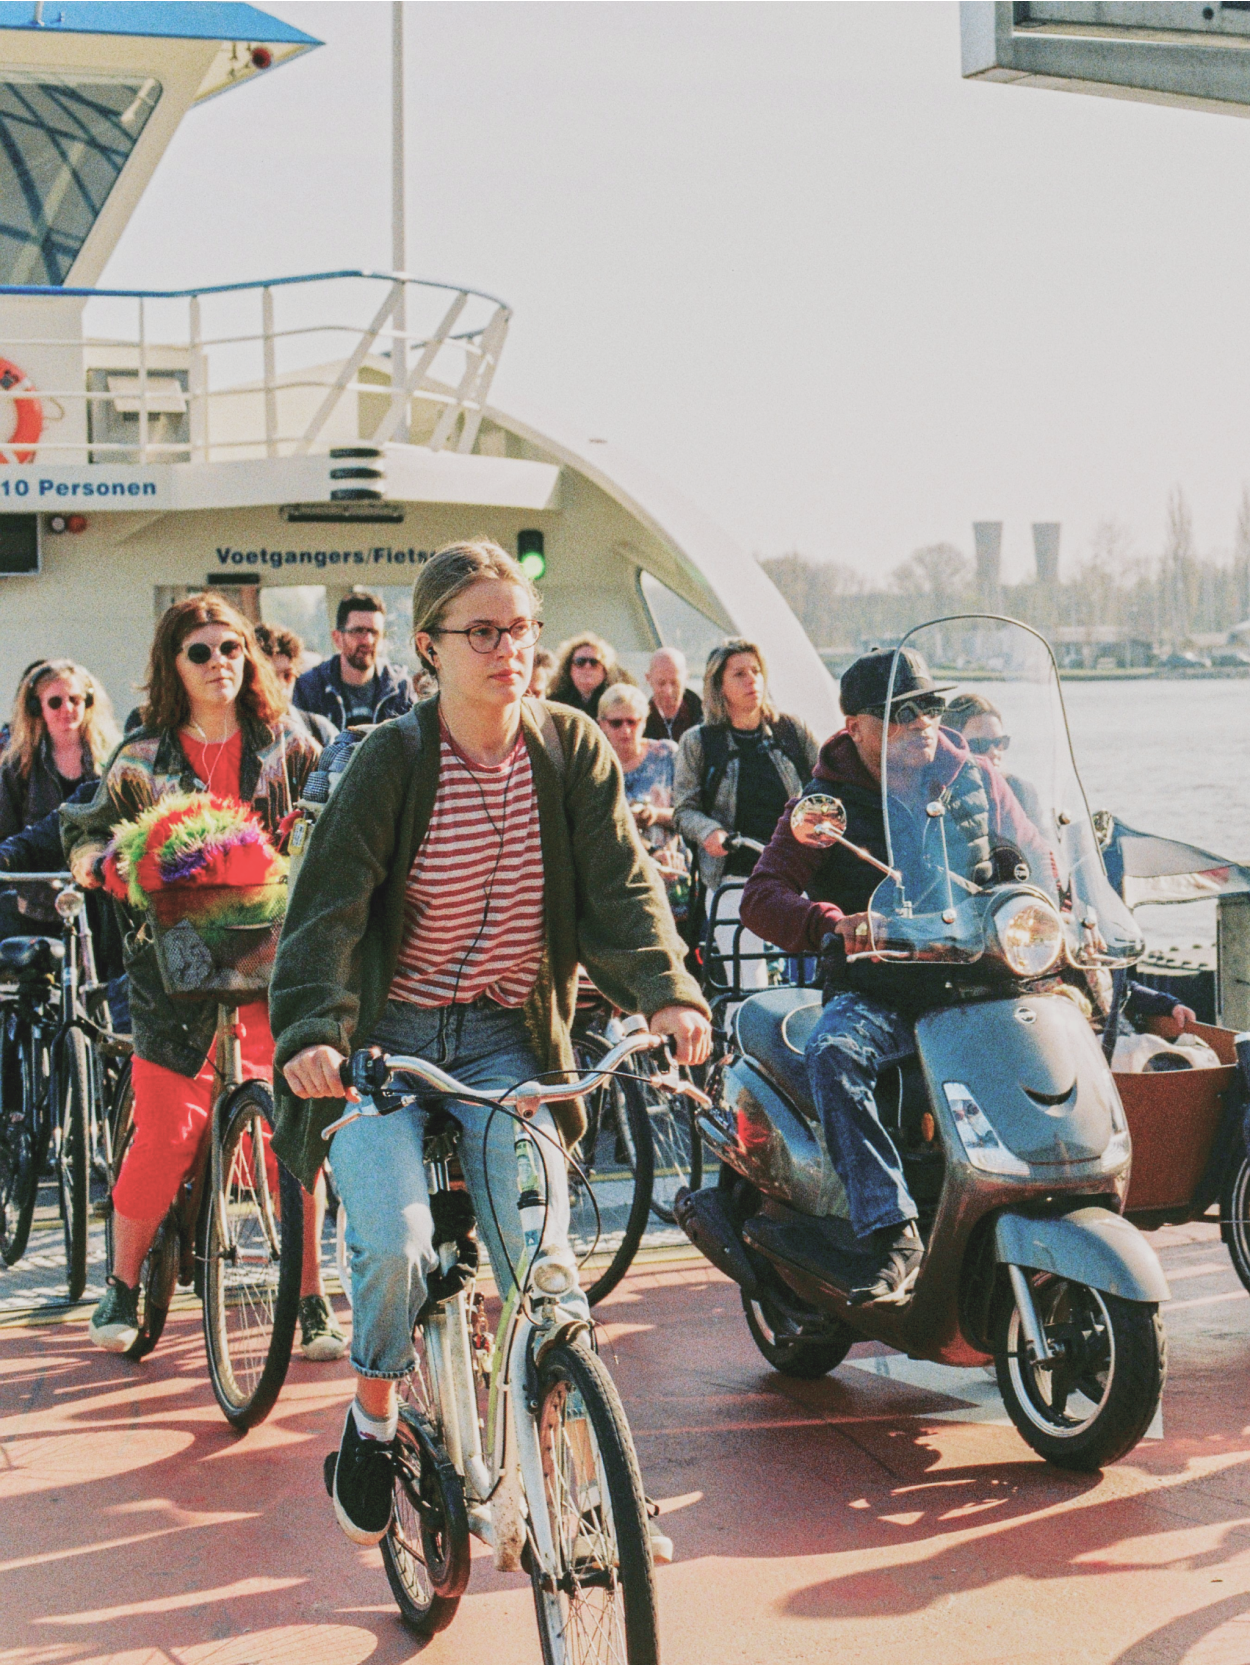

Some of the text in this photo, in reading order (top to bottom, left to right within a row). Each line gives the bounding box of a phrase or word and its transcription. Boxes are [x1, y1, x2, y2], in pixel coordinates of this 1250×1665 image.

[1, 479, 157, 497] 10 Personen
[216, 547, 435, 569] Voetgangers/Fiets
